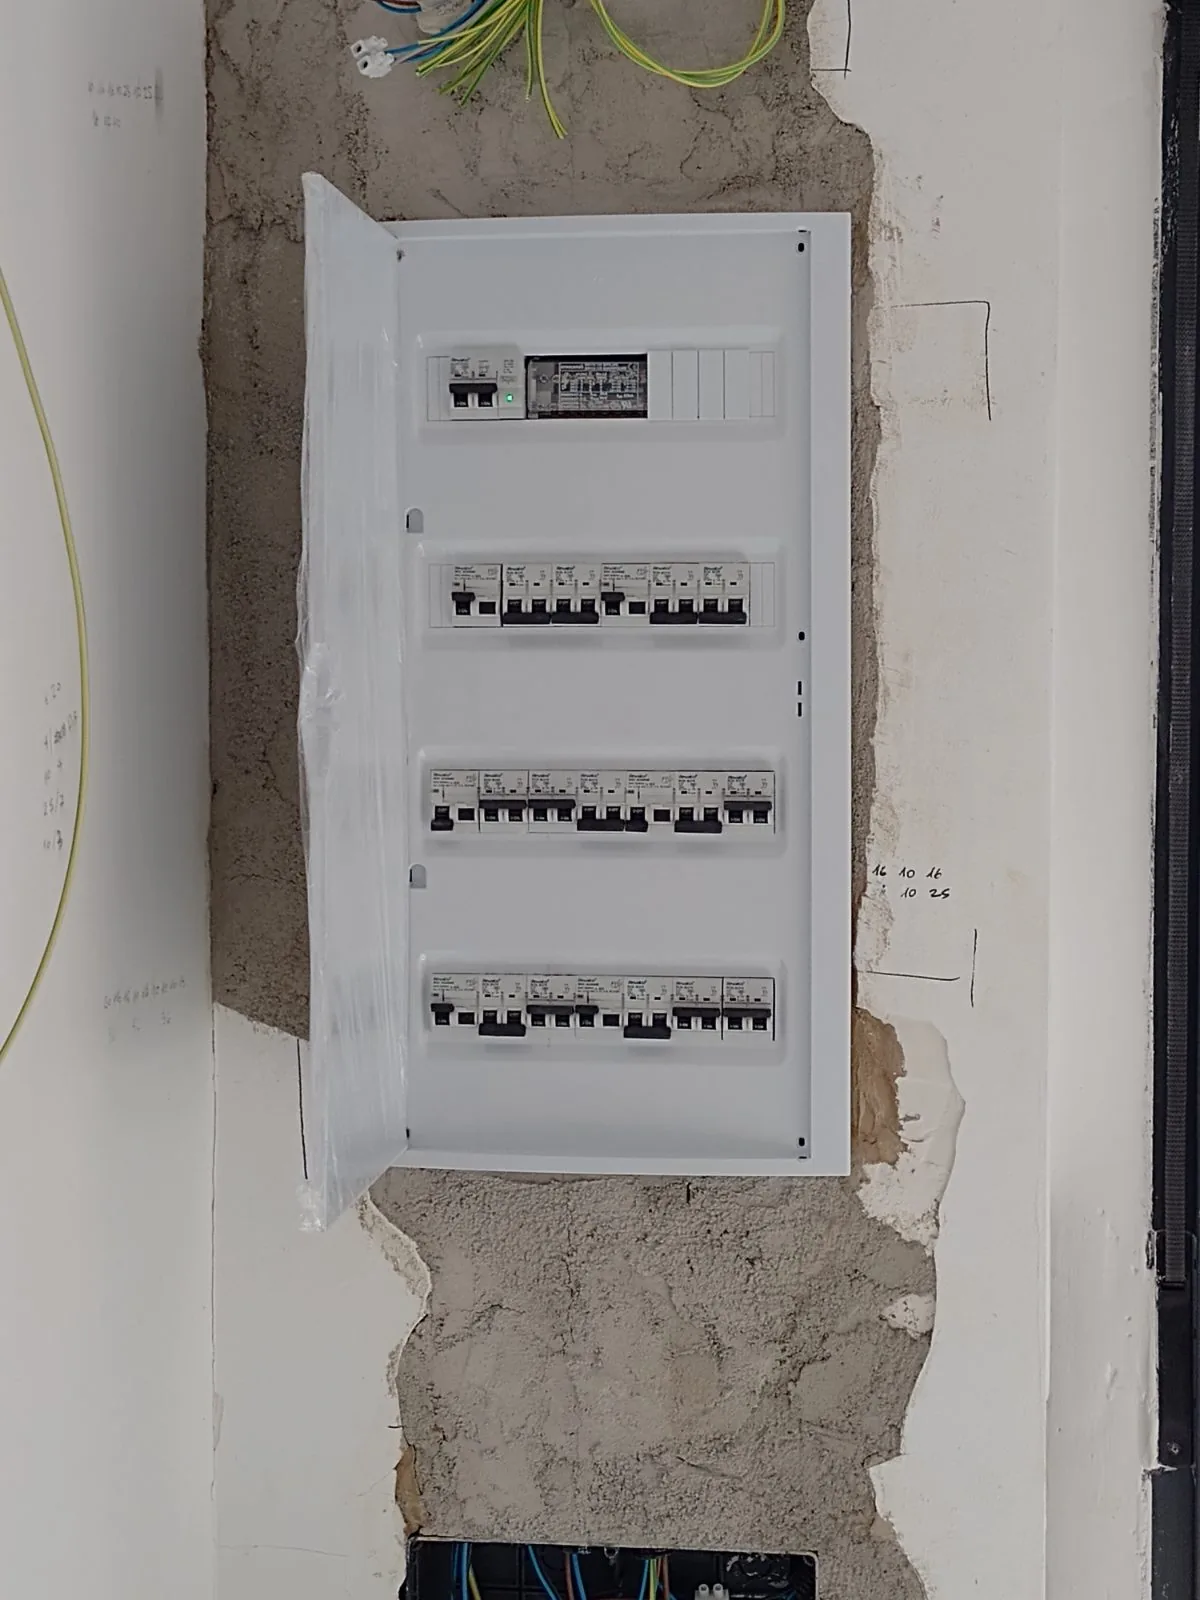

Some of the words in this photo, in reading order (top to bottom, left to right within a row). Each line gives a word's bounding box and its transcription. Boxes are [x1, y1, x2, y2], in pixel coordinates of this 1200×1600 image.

[872, 864, 887, 876] 16
[899, 866, 915, 878] 10
[926, 866, 943, 879] 16
[900, 887, 917, 898] 10
[929, 888, 950, 899] 25
